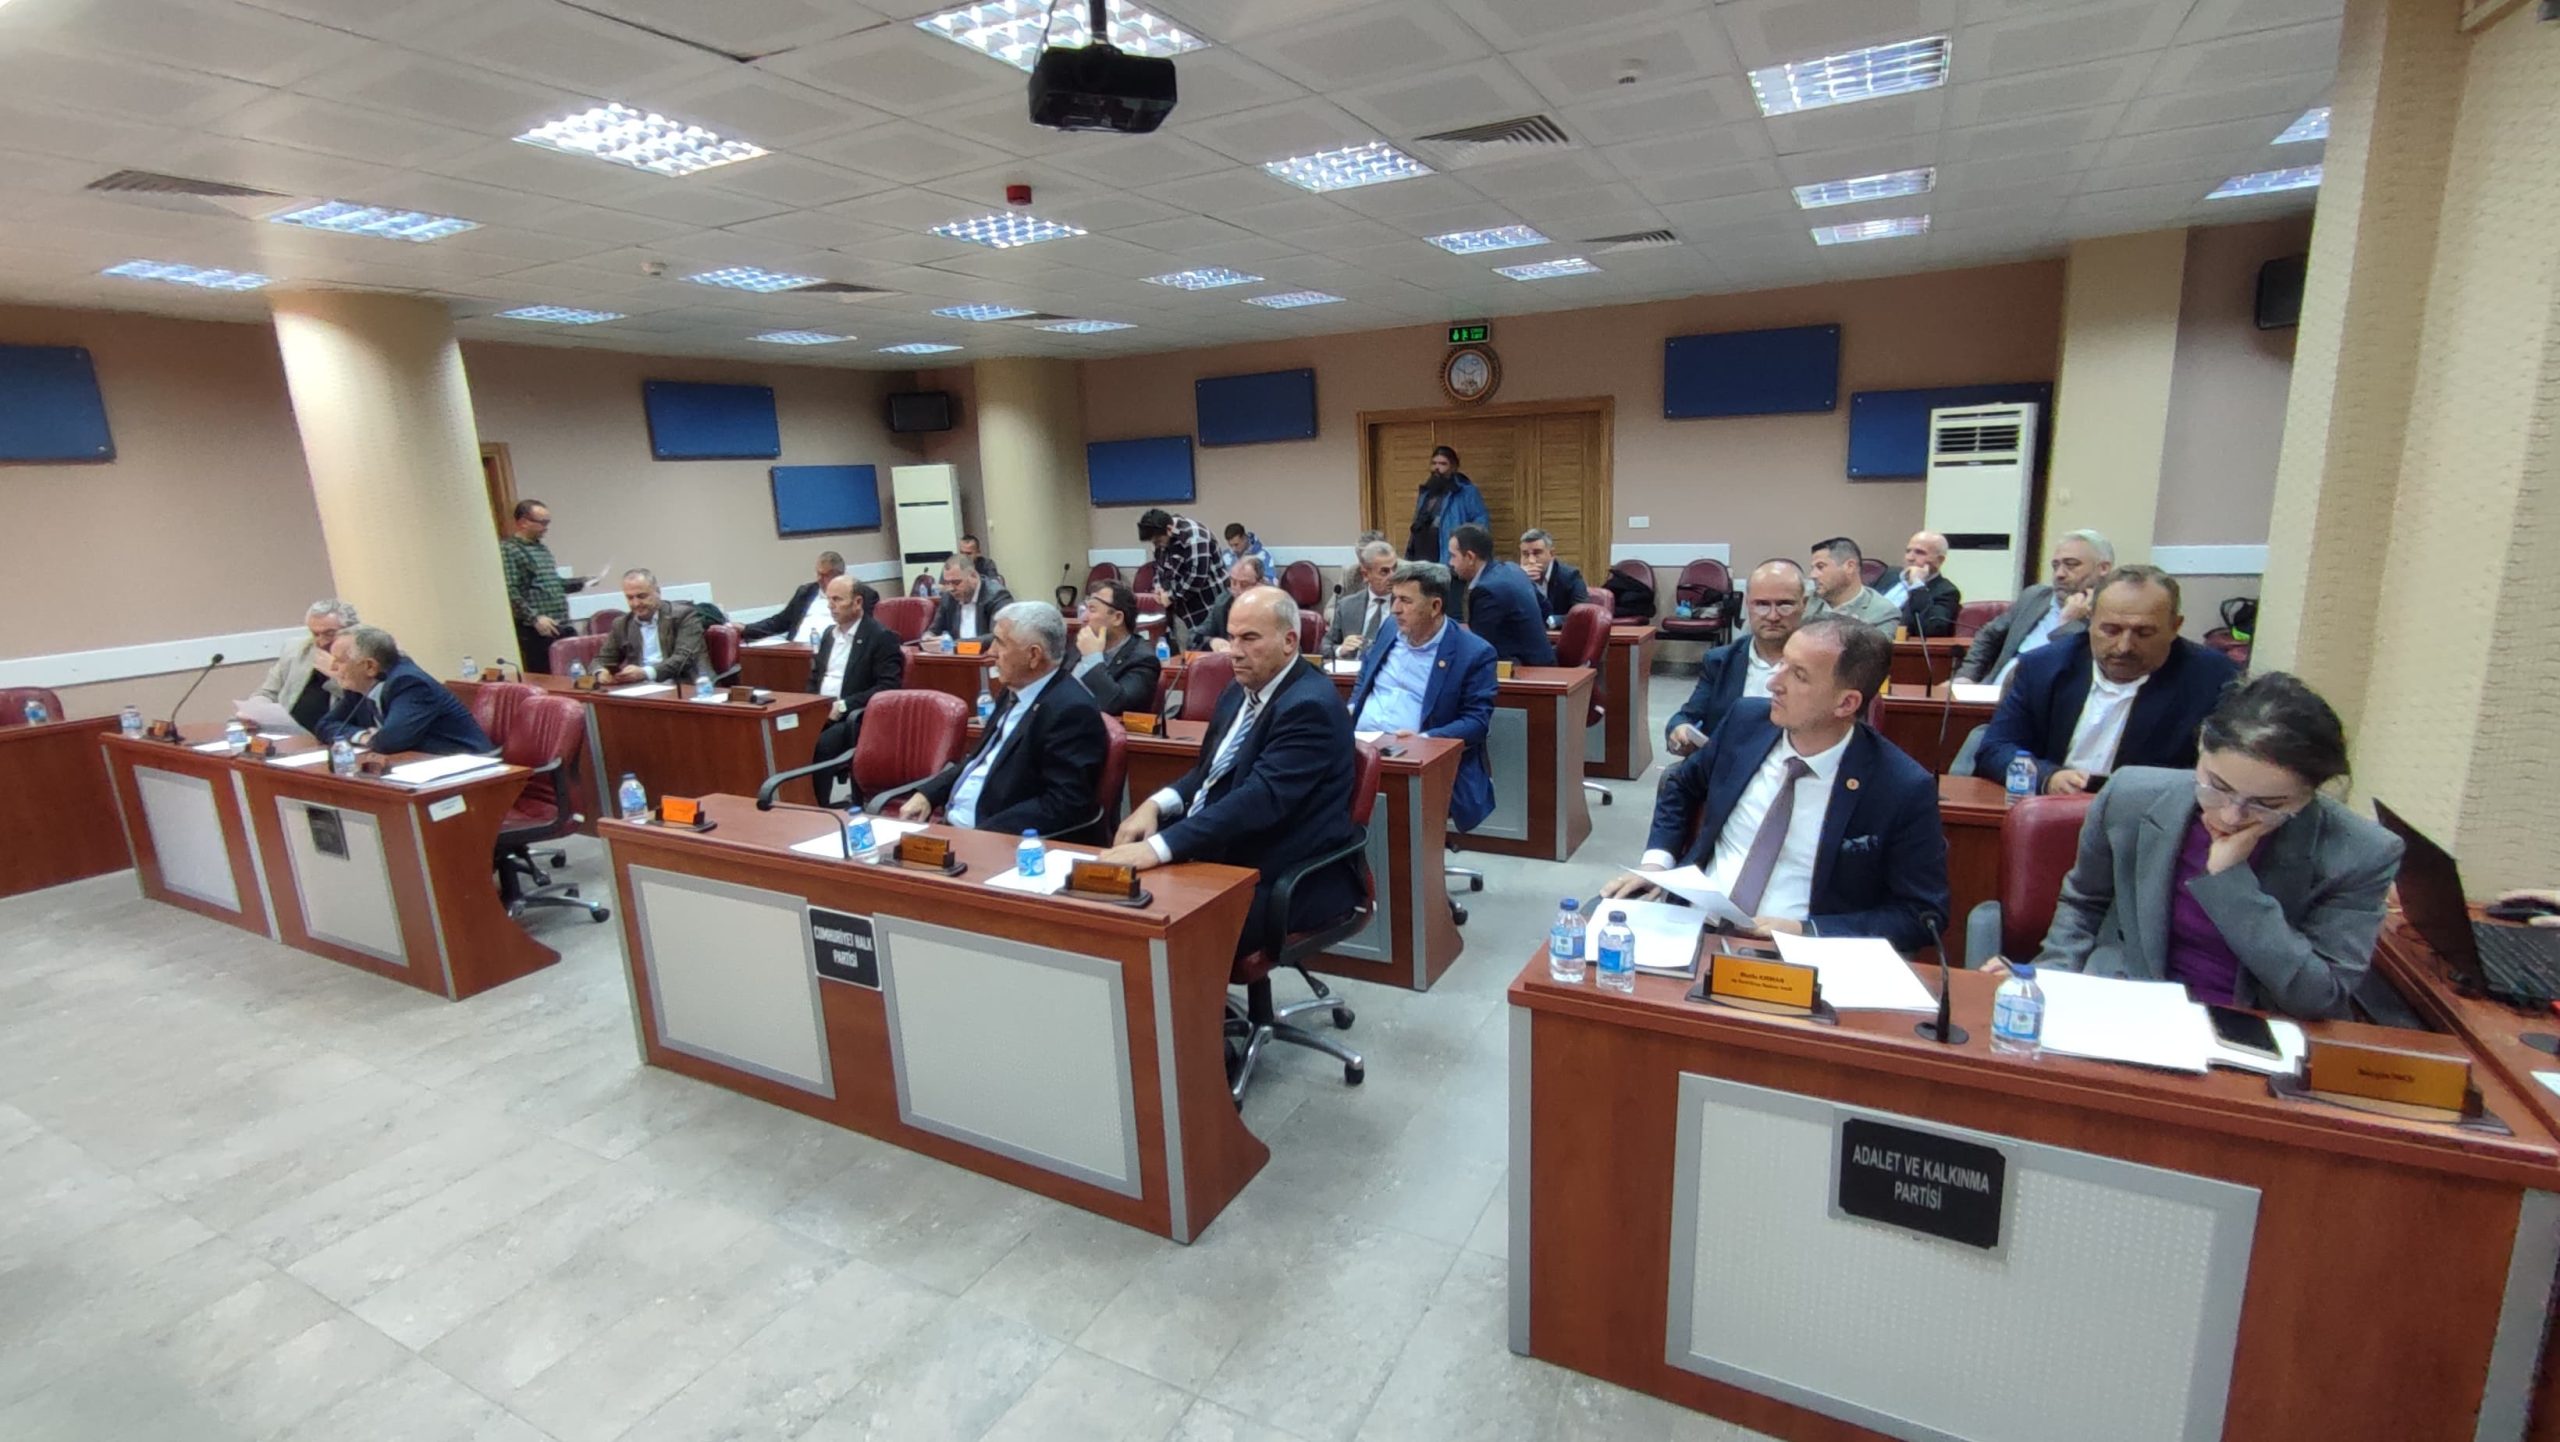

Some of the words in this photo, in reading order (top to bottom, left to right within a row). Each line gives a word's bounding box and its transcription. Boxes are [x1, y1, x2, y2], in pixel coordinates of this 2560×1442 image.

[1852, 1144, 1901, 1171] ADALET
[1904, 1155, 1920, 1177] VE
[1923, 1159, 1989, 1194] KALKINMA
[1894, 1181, 1941, 1210] PARTİSİ
